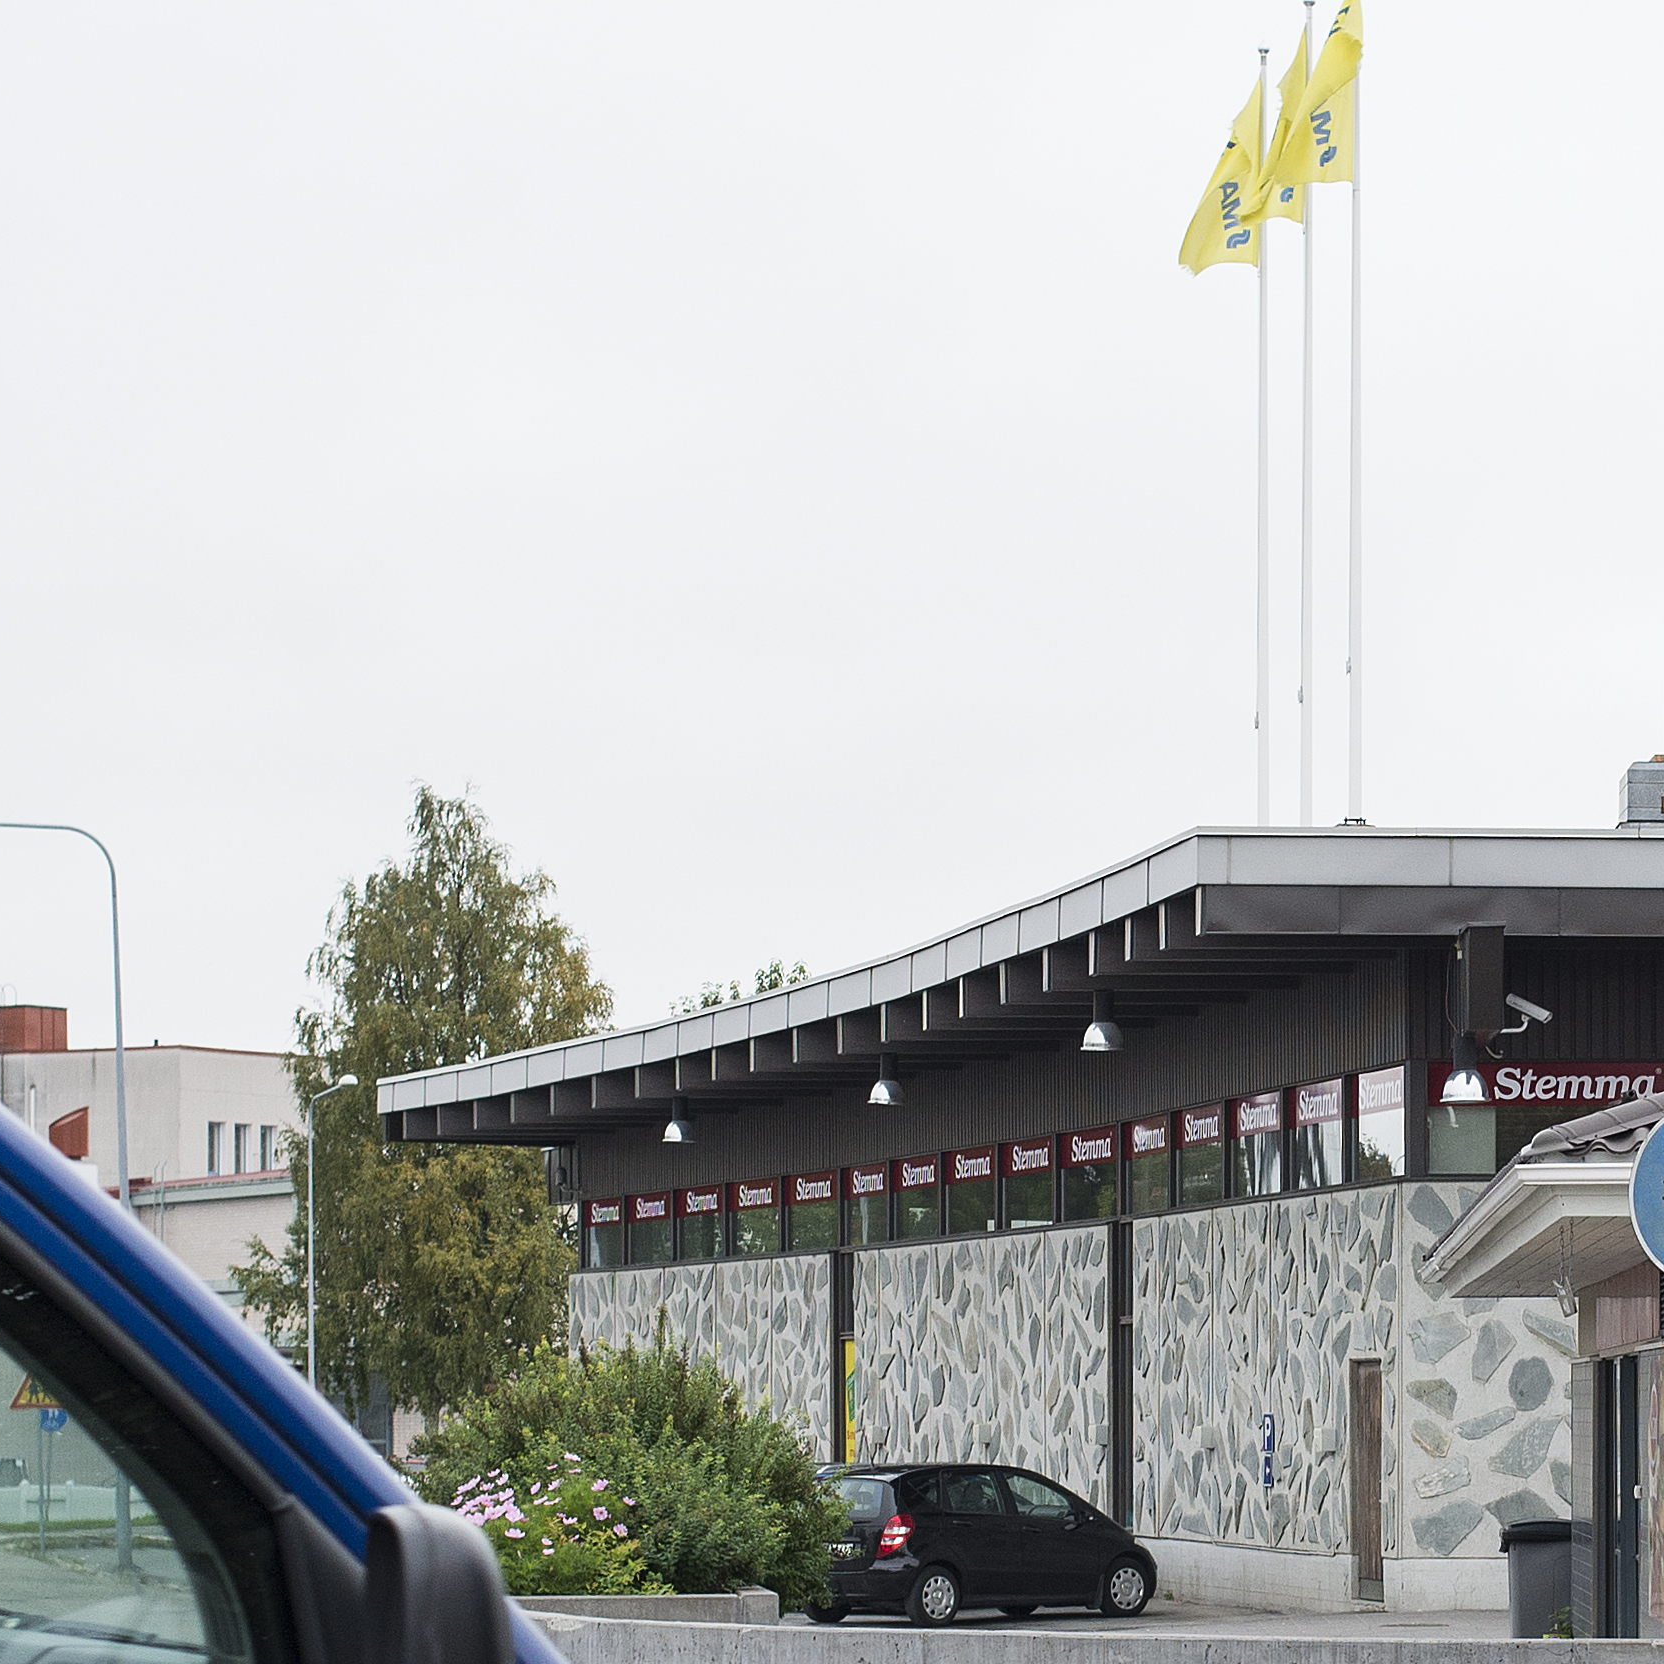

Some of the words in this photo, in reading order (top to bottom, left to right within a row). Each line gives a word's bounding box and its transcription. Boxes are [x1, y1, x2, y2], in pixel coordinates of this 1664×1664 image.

[1359, 1077, 1402, 1110] Stemma
[1494, 1066, 1656, 1102] Stemma
[1240, 1102, 1277, 1132] Stemma
[1298, 1090, 1338, 1121] Stemma
[1071, 1135, 1112, 1163] Stemma
